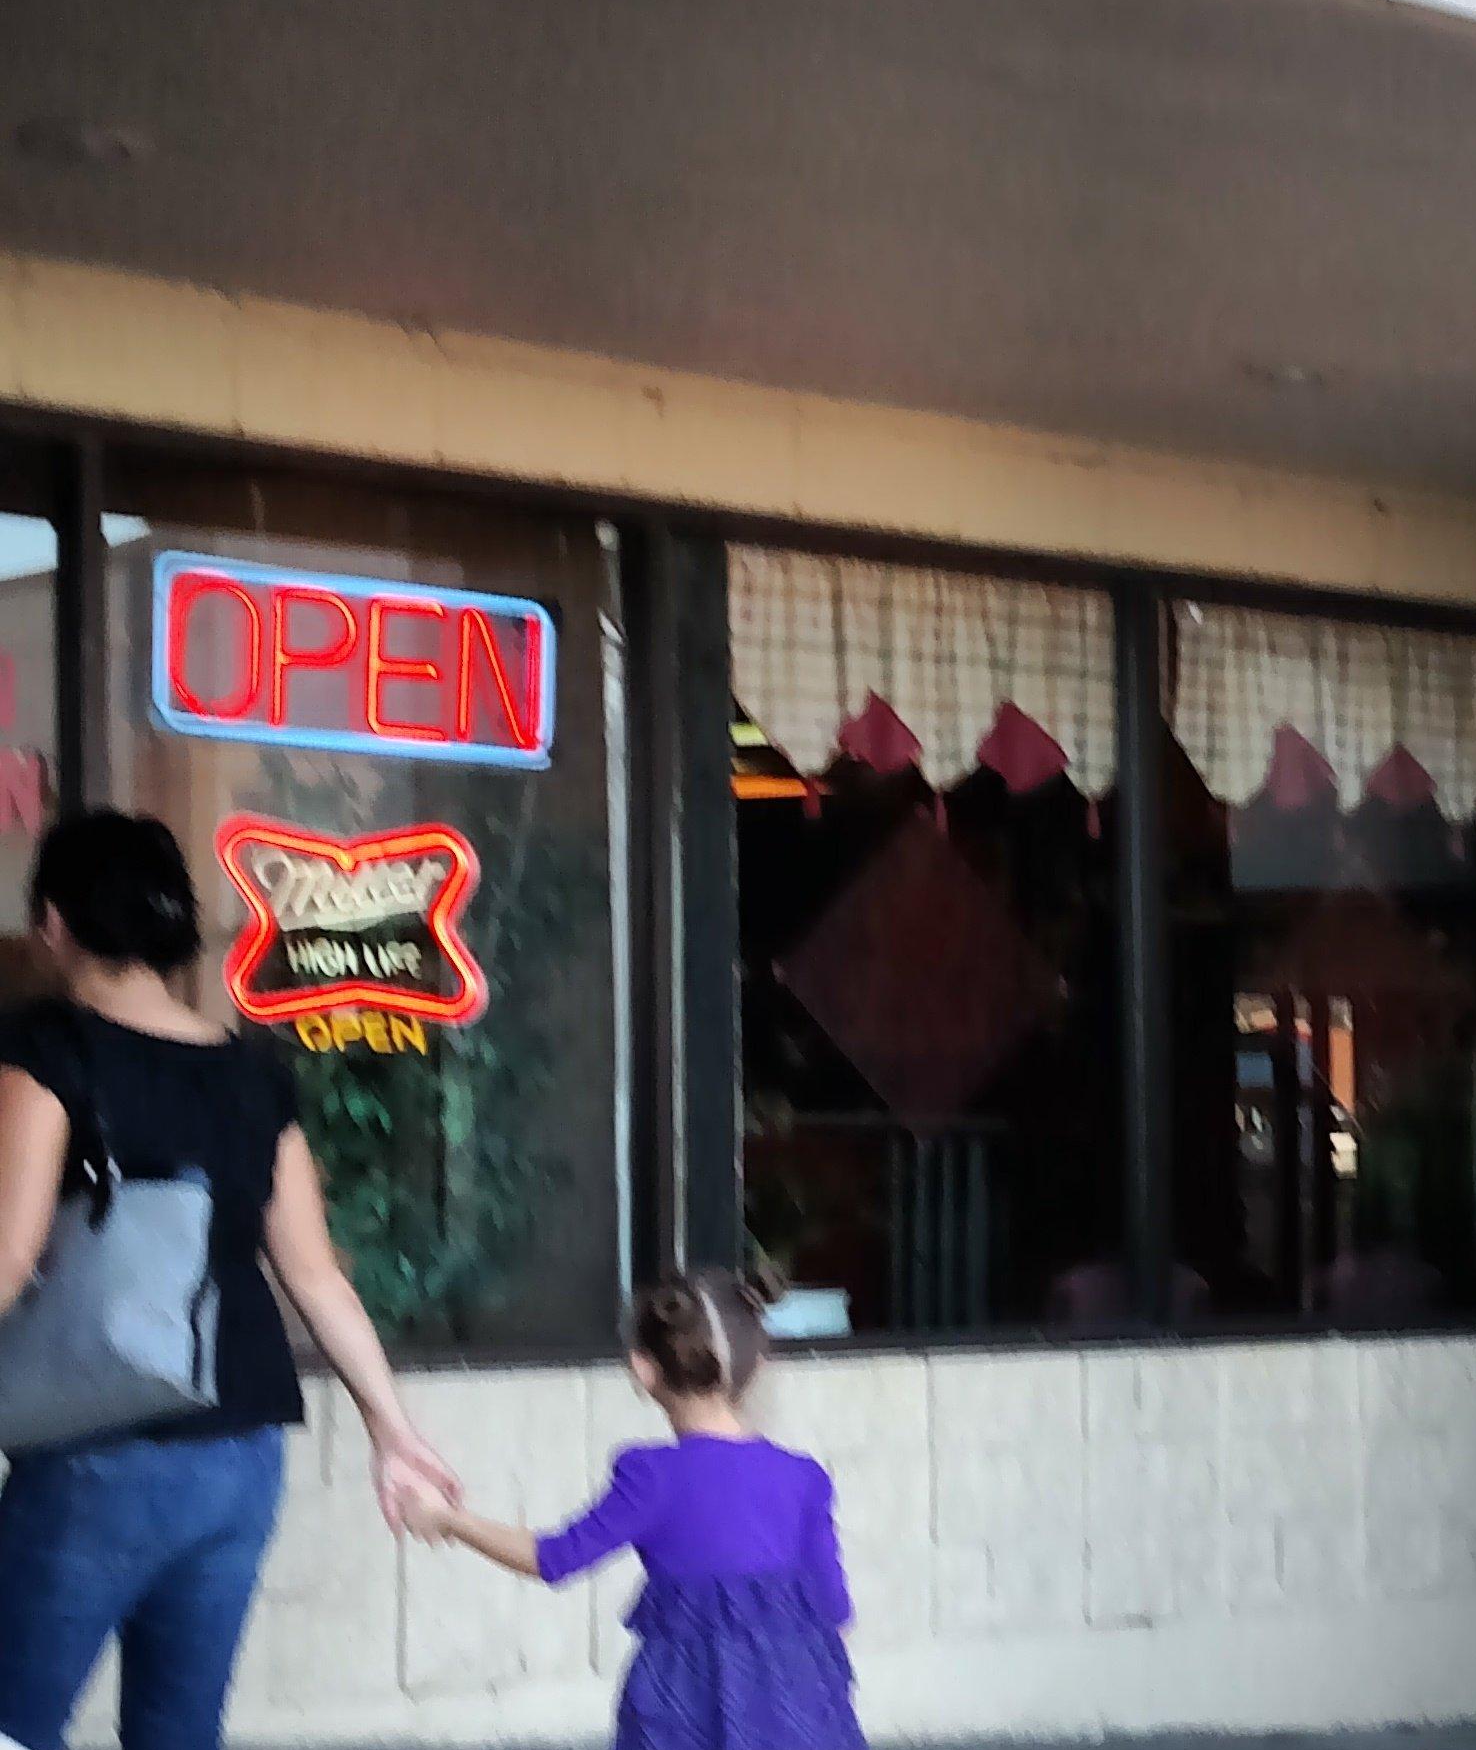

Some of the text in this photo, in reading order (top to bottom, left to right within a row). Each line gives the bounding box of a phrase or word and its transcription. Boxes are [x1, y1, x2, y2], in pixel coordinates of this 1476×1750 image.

[167, 569, 544, 752] OPEN
[250, 848, 446, 931] Miller
[295, 1007, 428, 1055] OPEN
